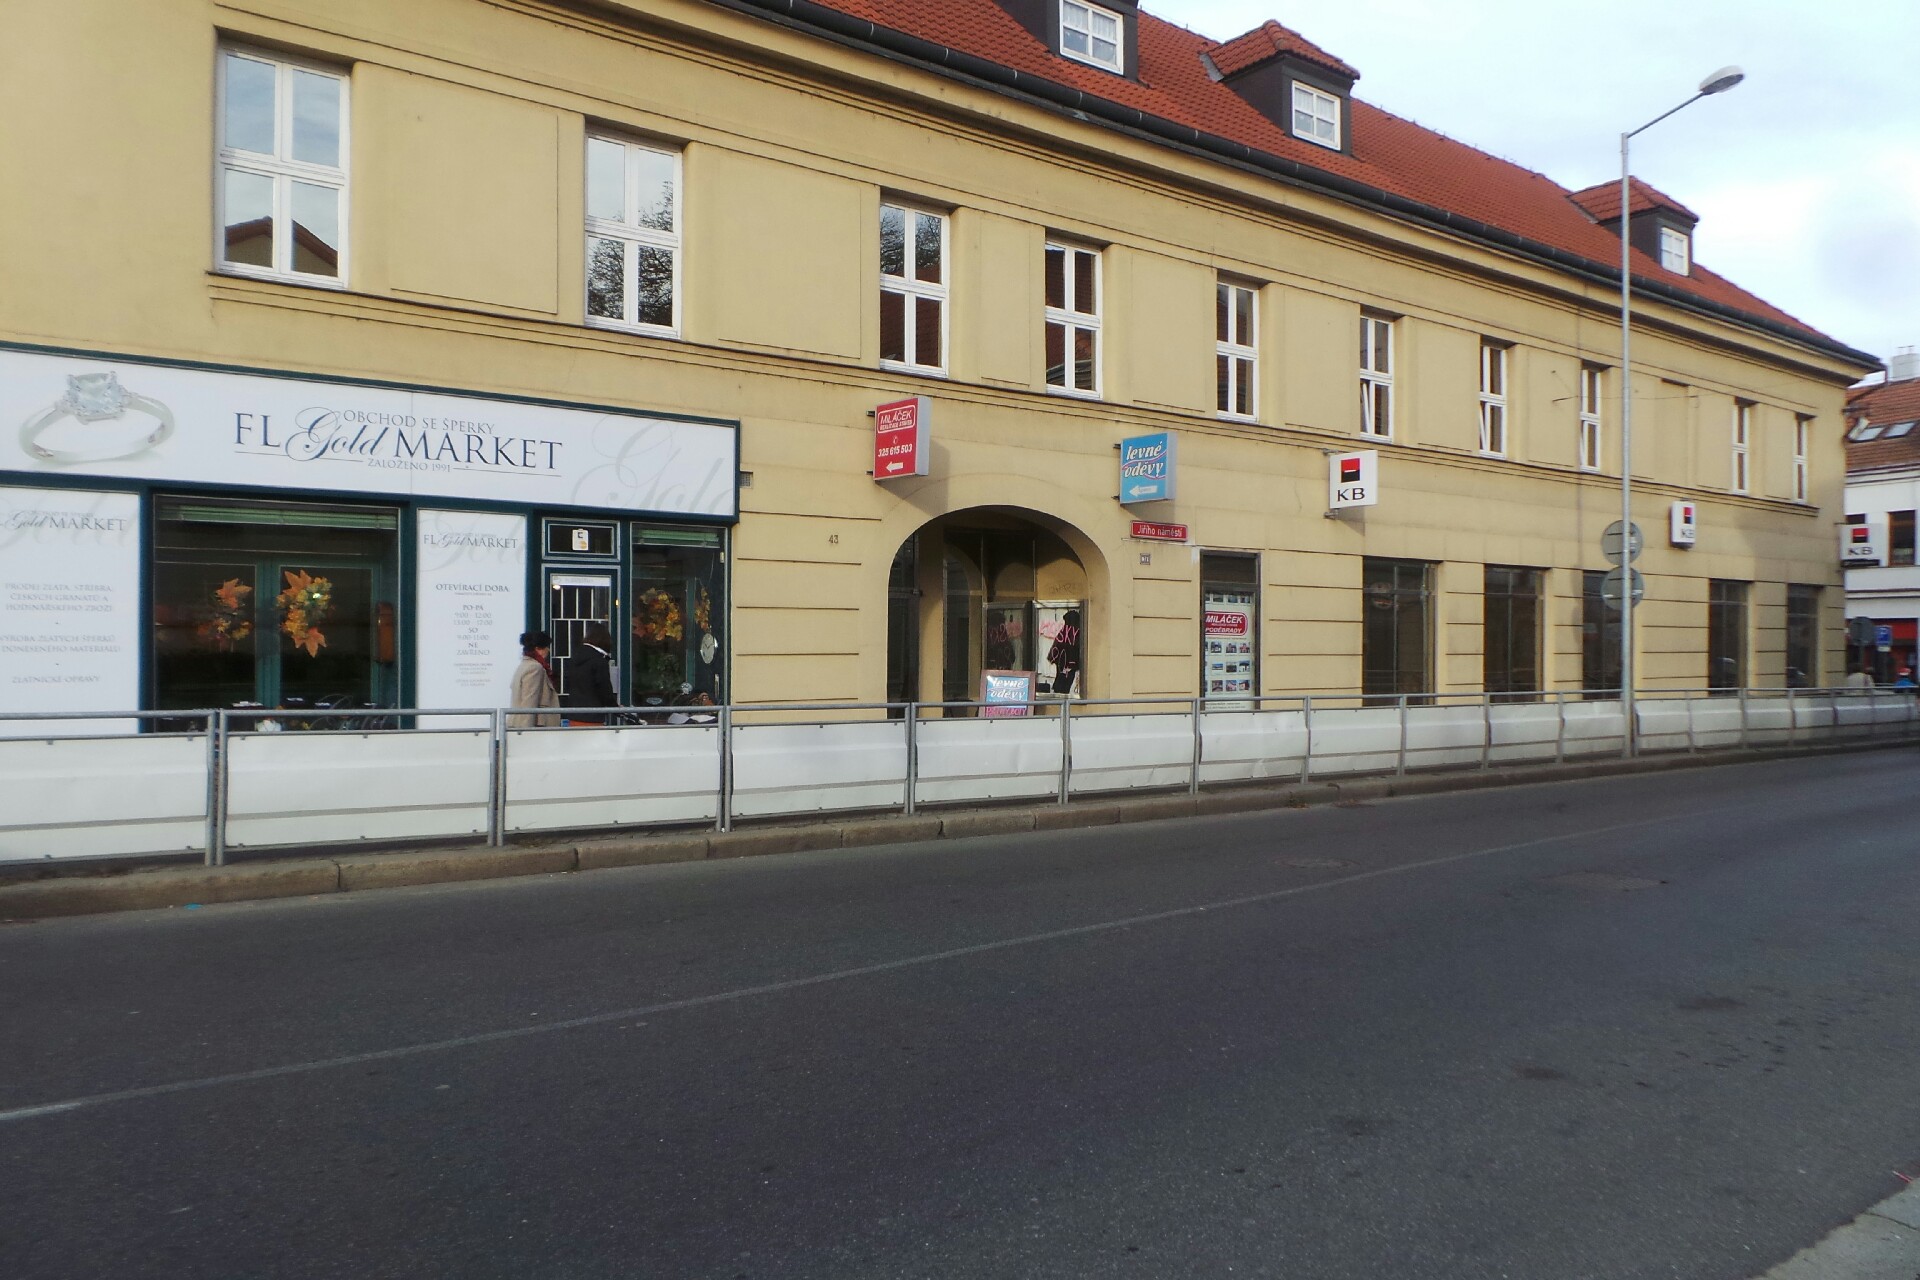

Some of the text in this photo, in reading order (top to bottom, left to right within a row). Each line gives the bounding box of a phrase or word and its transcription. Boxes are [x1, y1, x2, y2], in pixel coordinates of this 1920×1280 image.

[343, 409, 495, 434] OBCHOD SE ŠPERKY
[285, 406, 389, 462] Gold
[393, 427, 563, 470] MARKET
[878, 443, 912, 457] 325 615 503
[1126, 441, 1162, 461] levné
[367, 458, 451, 473] ZALOŽENO 1991
[1124, 461, 1164, 478] oděvy
[1337, 487, 1365, 502] KB
[49, 516, 127, 531] MARKET
[467, 537, 518, 549] MARKET
[828, 534, 839, 544] 43
[1848, 546, 1873, 556] KB
[435, 582, 482, 592] OTEVÍRACÍ
[1205, 614, 1243, 624] MILÁČEK
